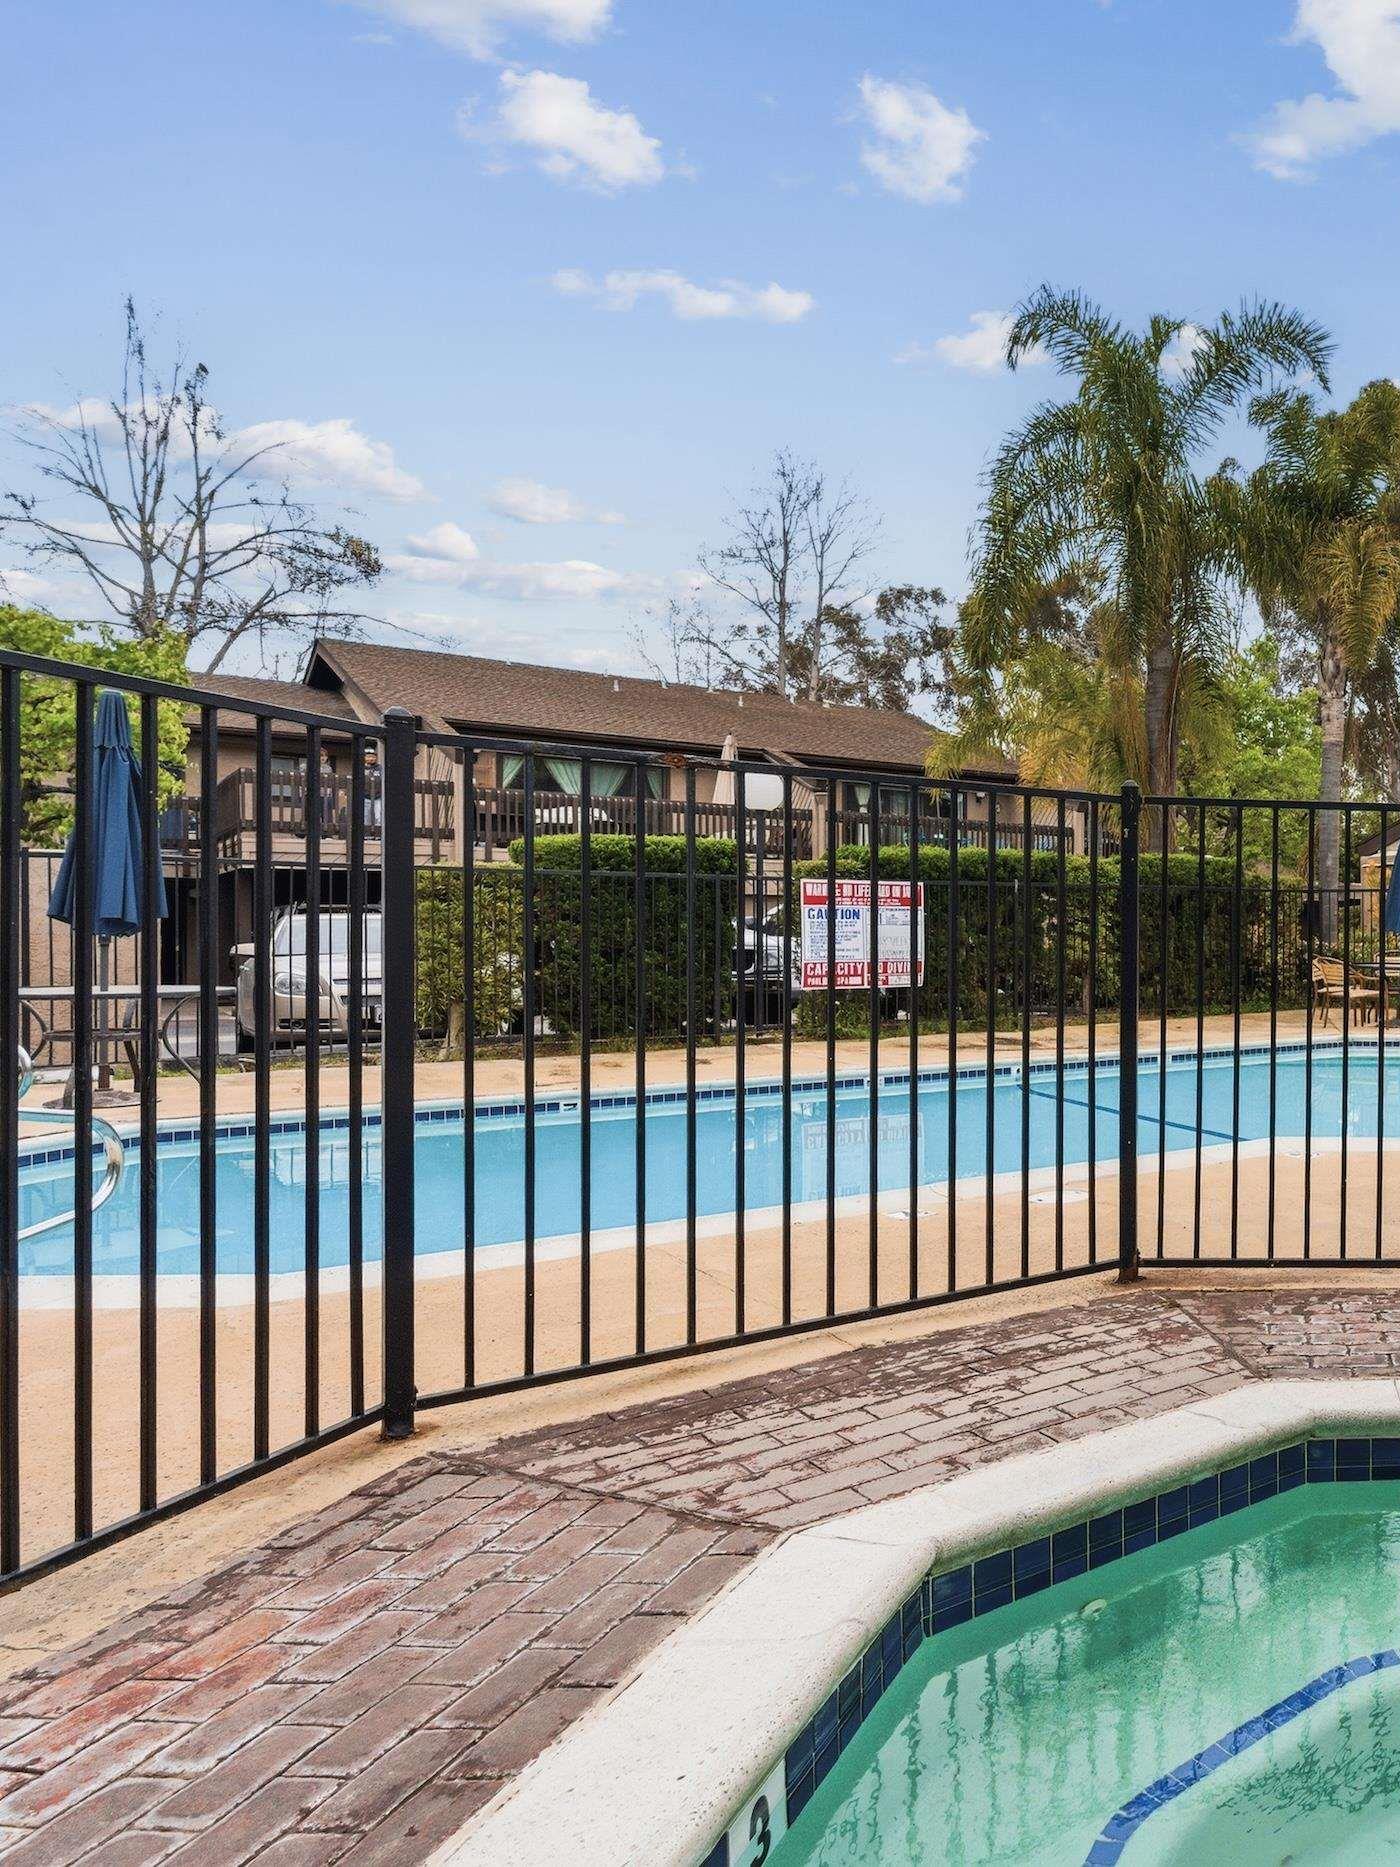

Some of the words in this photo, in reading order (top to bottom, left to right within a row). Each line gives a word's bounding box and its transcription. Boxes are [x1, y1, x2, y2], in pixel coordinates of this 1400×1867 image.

[806, 962, 863, 976] CAPCITY
[887, 961, 914, 974] DIVI
[749, 1795, 772, 1867] 3
